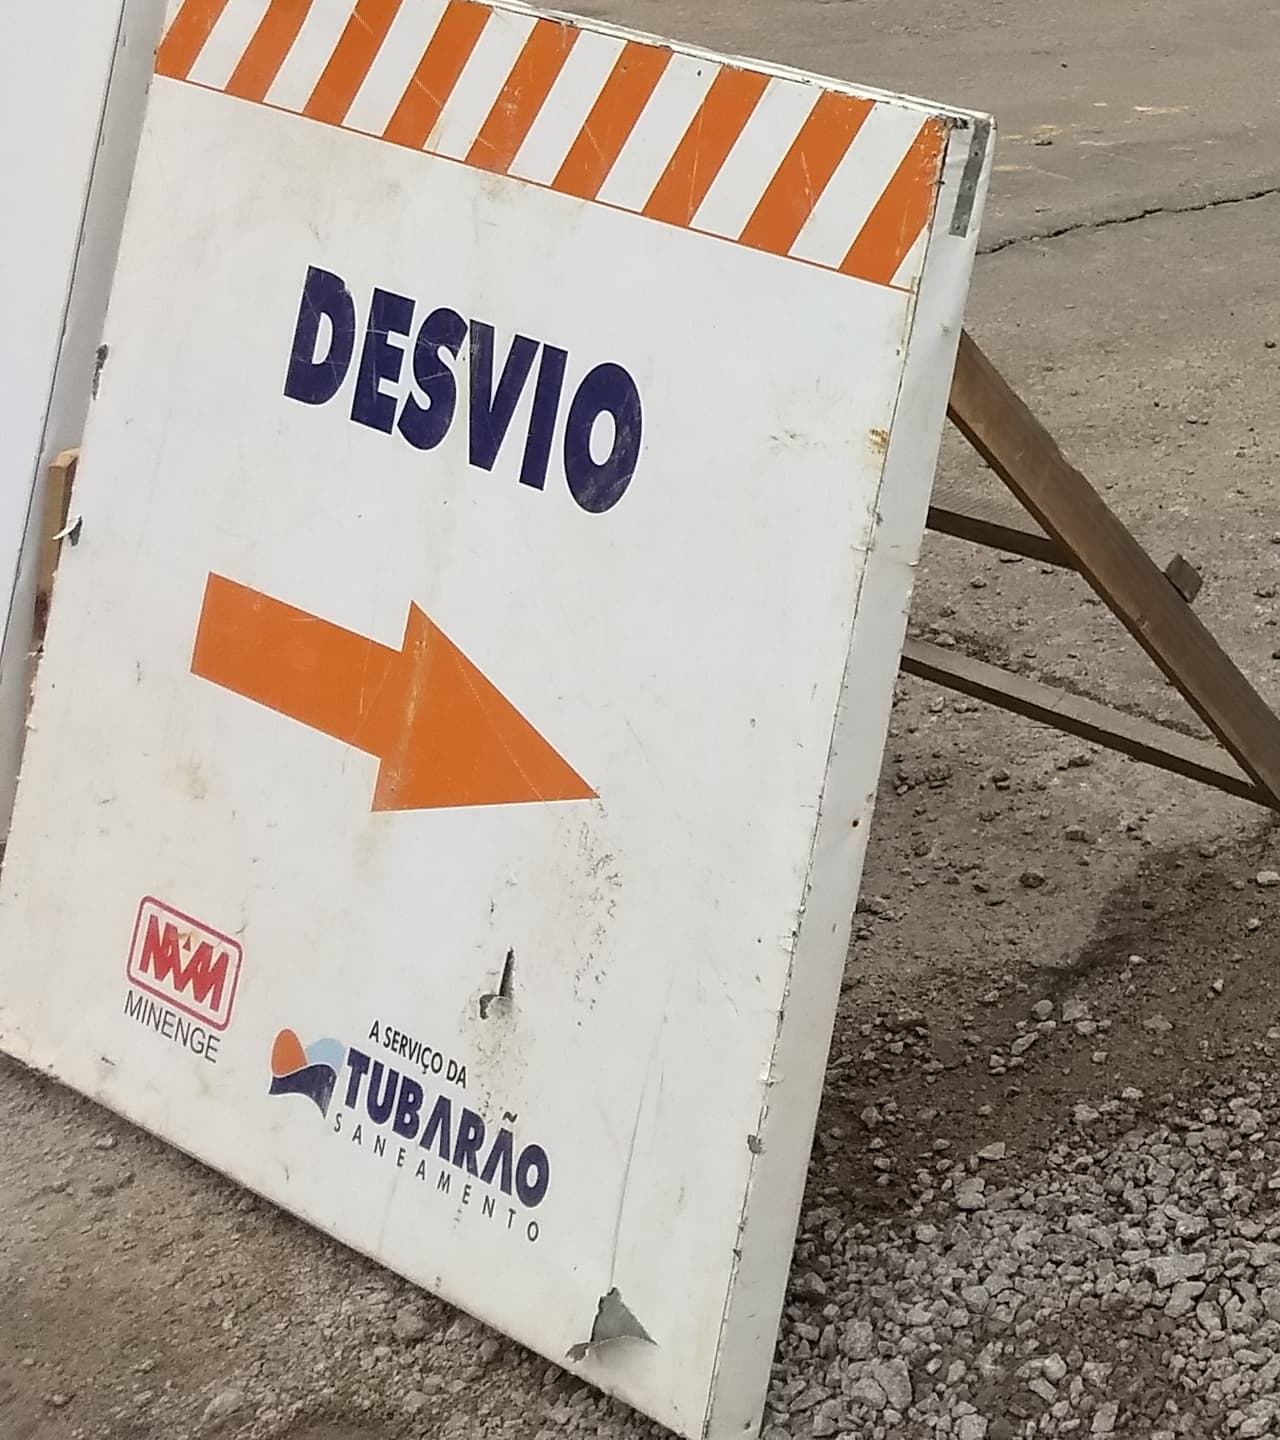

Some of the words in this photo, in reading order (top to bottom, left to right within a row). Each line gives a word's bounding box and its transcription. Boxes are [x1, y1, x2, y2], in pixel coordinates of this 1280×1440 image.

[283, 265, 643, 514] DESVIO
[124, 989, 221, 1064] MINENGE
[369, 1020, 380, 1043] A
[382, 1026, 443, 1075] SERVIÇO
[446, 1059, 467, 1089] DA
[333, 1112, 540, 1243] SANEAMENTO
[344, 1047, 551, 1209] TUBARÃO
